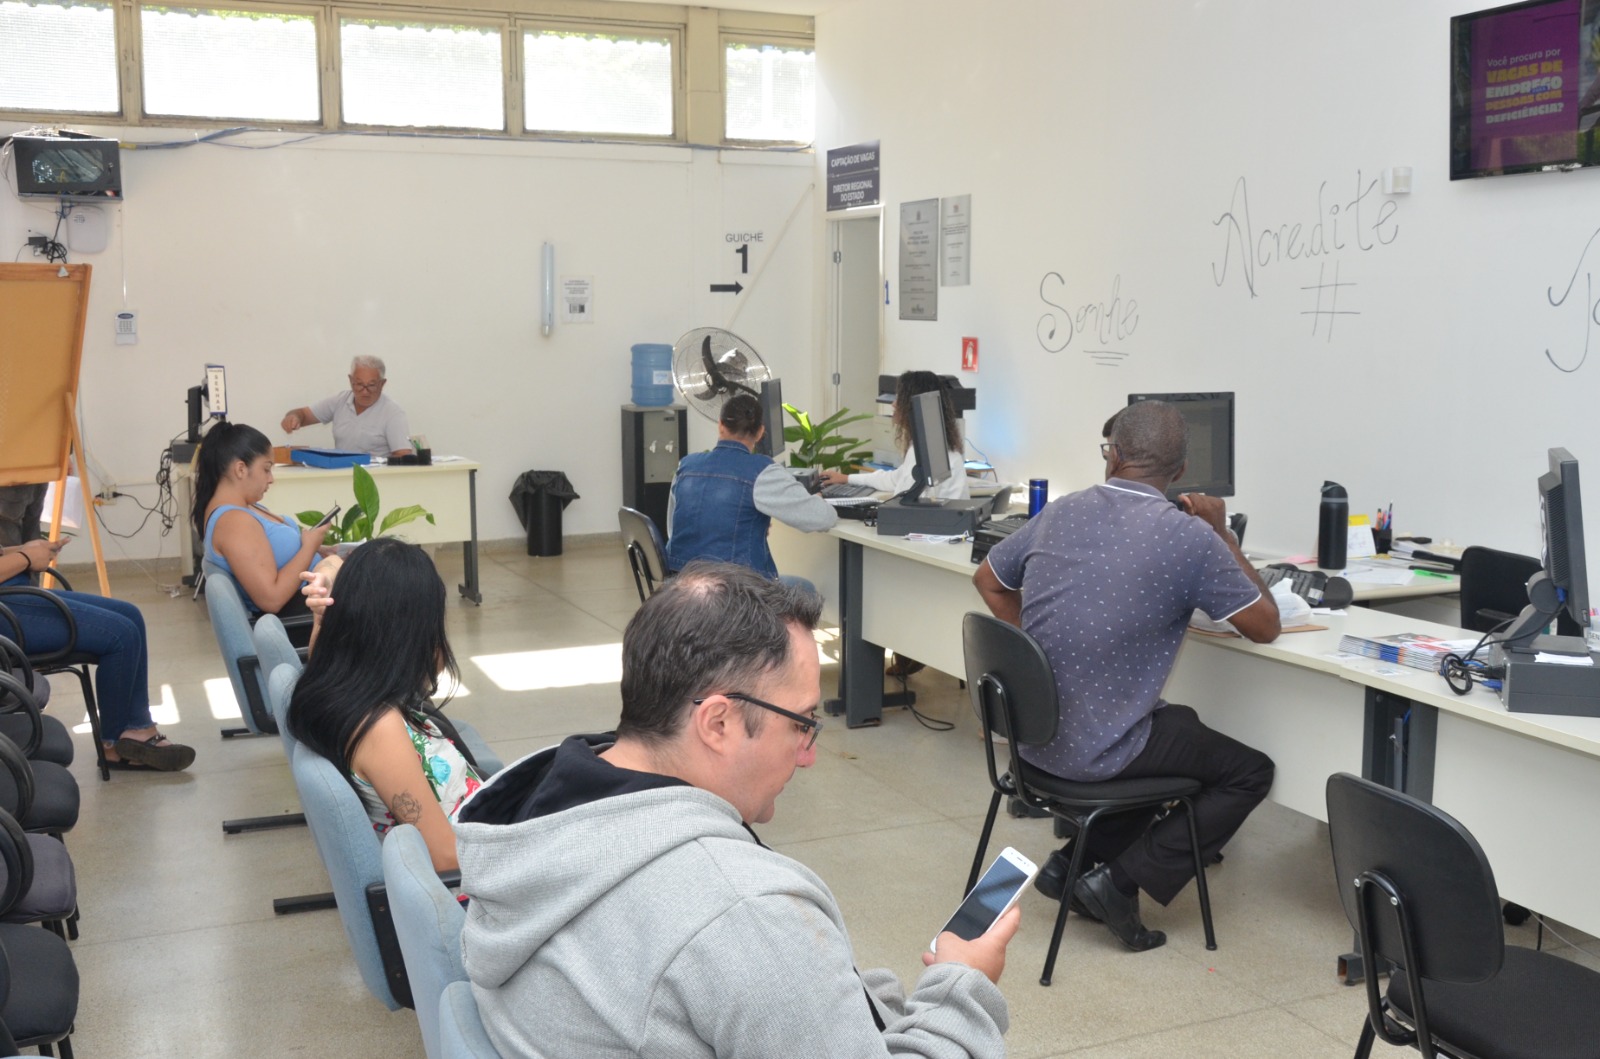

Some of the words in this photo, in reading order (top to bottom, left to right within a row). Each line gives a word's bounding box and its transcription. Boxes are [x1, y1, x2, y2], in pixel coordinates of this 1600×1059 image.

[1487, 56, 1507, 67] Você
[1509, 50, 1543, 65] procura
[1545, 48, 1561, 59] por
[1540, 59, 1563, 74] DE
[1485, 94, 1535, 111] PESSOAS
[1535, 89, 1563, 101] COM
[1486, 102, 1564, 124] DEFICIÊNCIA?
[831, 155, 853, 167] CAPTAÇÃO
[854, 155, 860, 164] DE
[860, 152, 875, 161] VAGAS
[833, 183, 850, 193] DIRETOR
[851, 180, 873, 190] REGIONAL
[841, 193, 847, 202] DO
[848, 191, 864, 200] ESTADO
[1212, 169, 1399, 299] Acredite
[736, 244, 748, 273] 1
[1036, 271, 1139, 354] Sonhe
